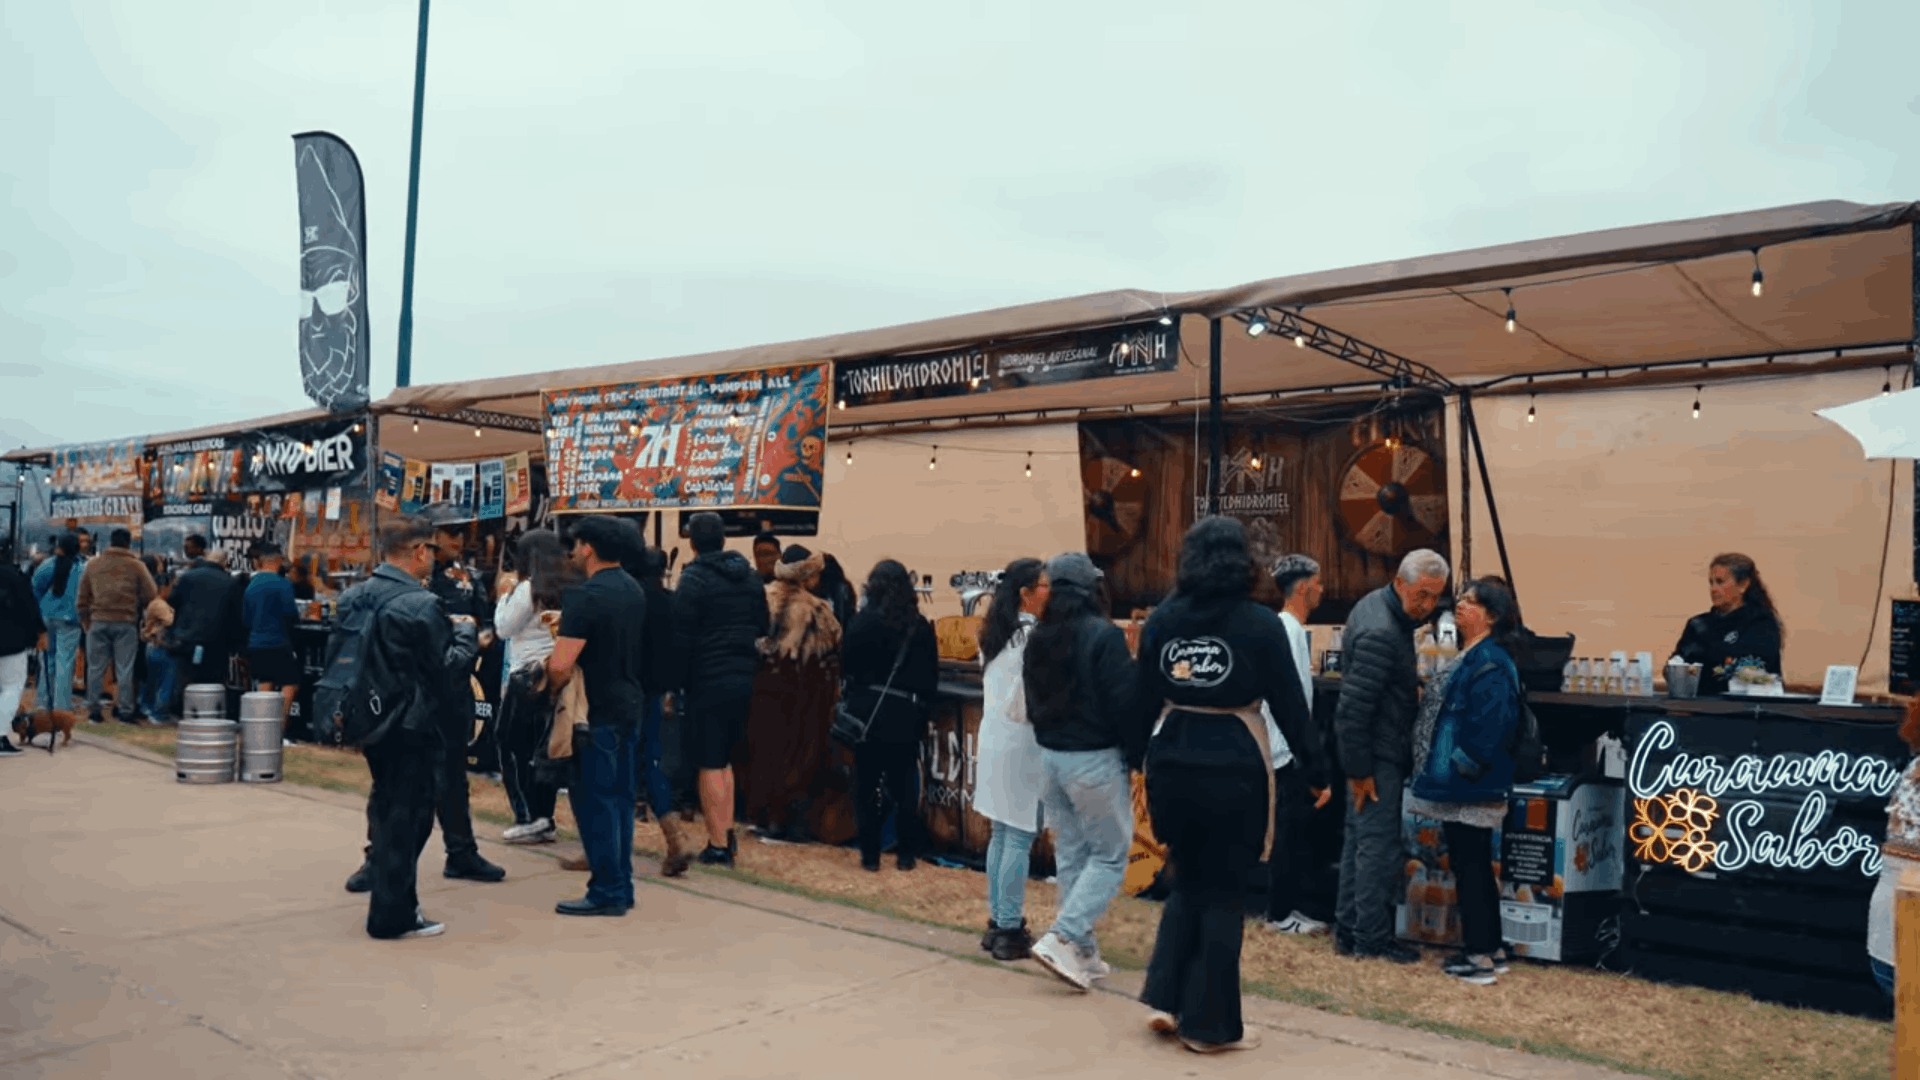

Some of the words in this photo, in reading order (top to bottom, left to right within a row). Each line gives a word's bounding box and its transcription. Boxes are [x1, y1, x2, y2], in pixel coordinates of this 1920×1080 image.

[767, 375, 791, 389] ALE
[1629, 720, 1900, 797] Curauma
[1714, 790, 1882, 876] Sabor
